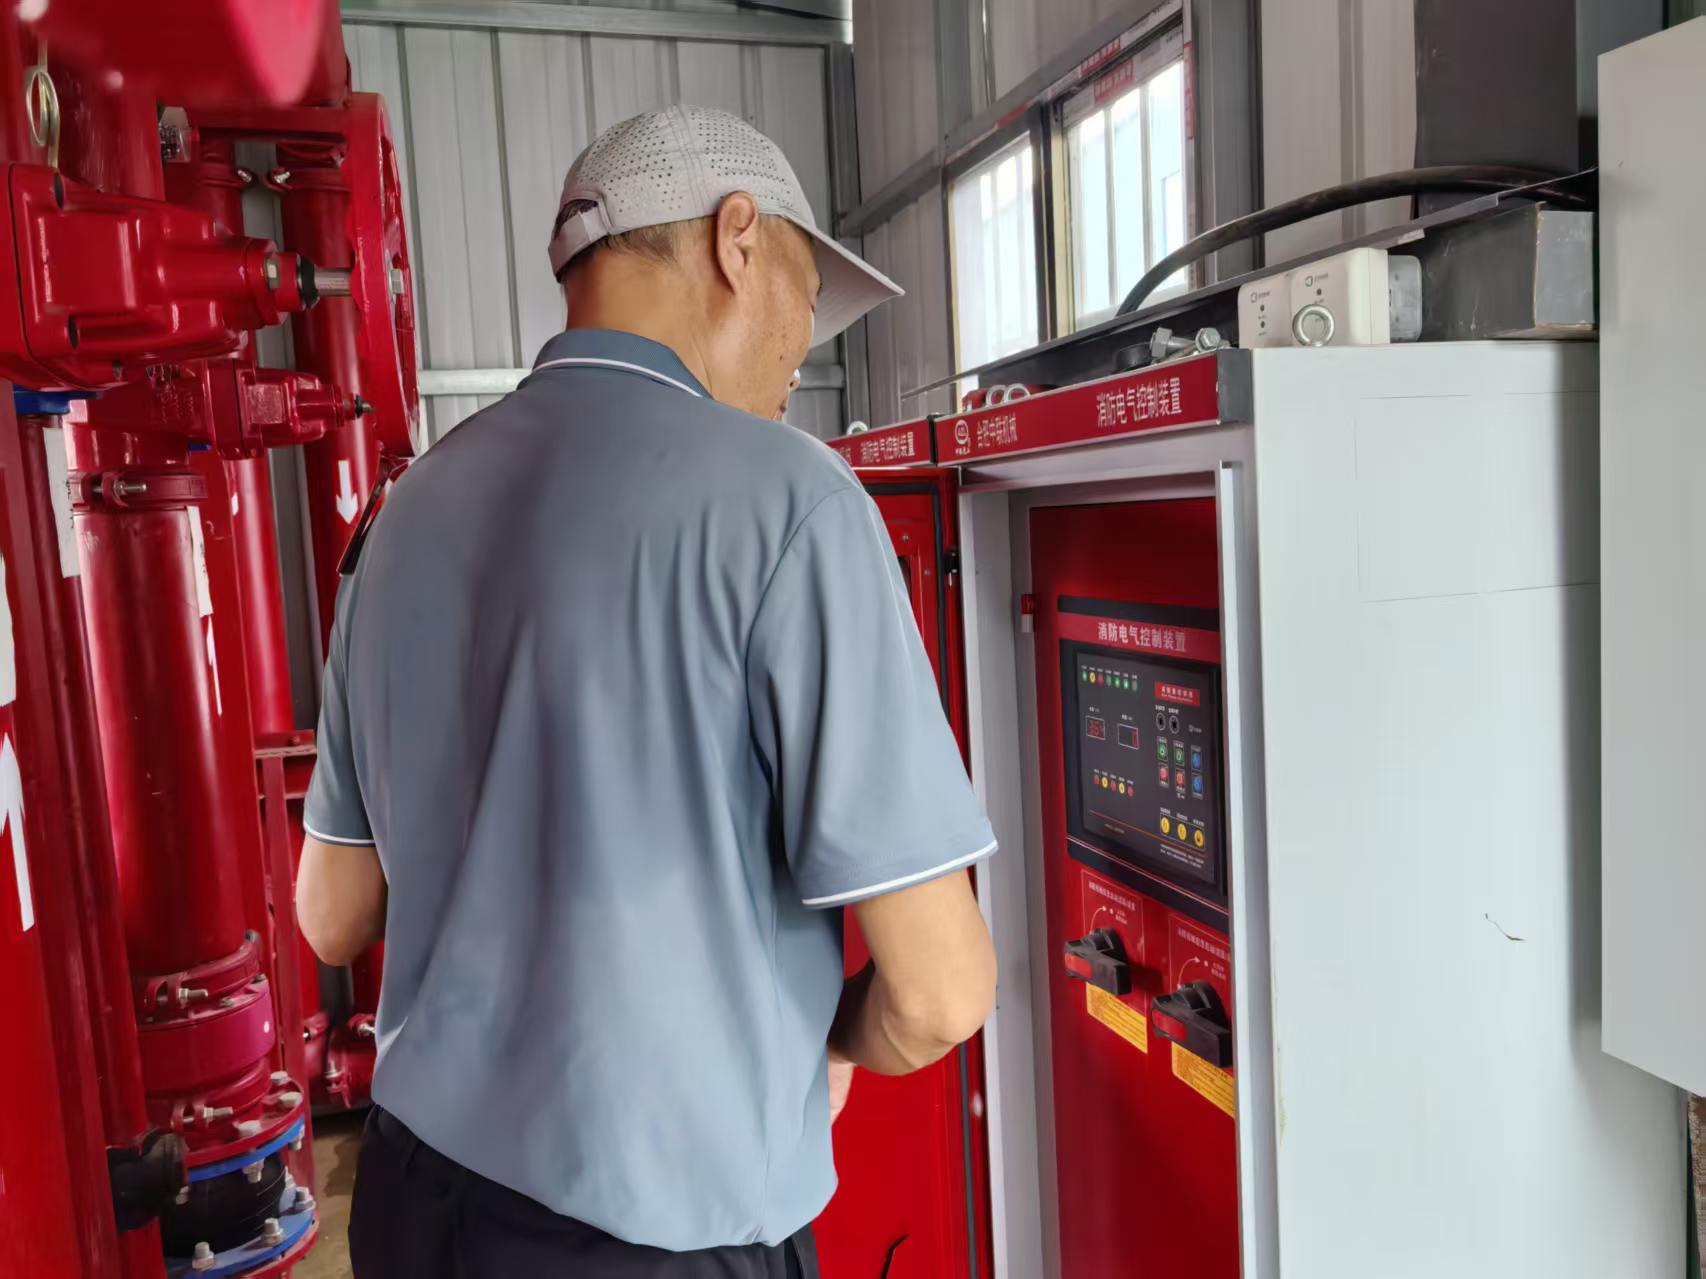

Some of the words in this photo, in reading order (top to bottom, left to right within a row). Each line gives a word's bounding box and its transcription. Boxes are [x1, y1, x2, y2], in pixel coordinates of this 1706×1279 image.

[1096, 377, 1182, 428] 消防电气控制装置
[1098, 622, 1187, 652] 消防电气控制装置
